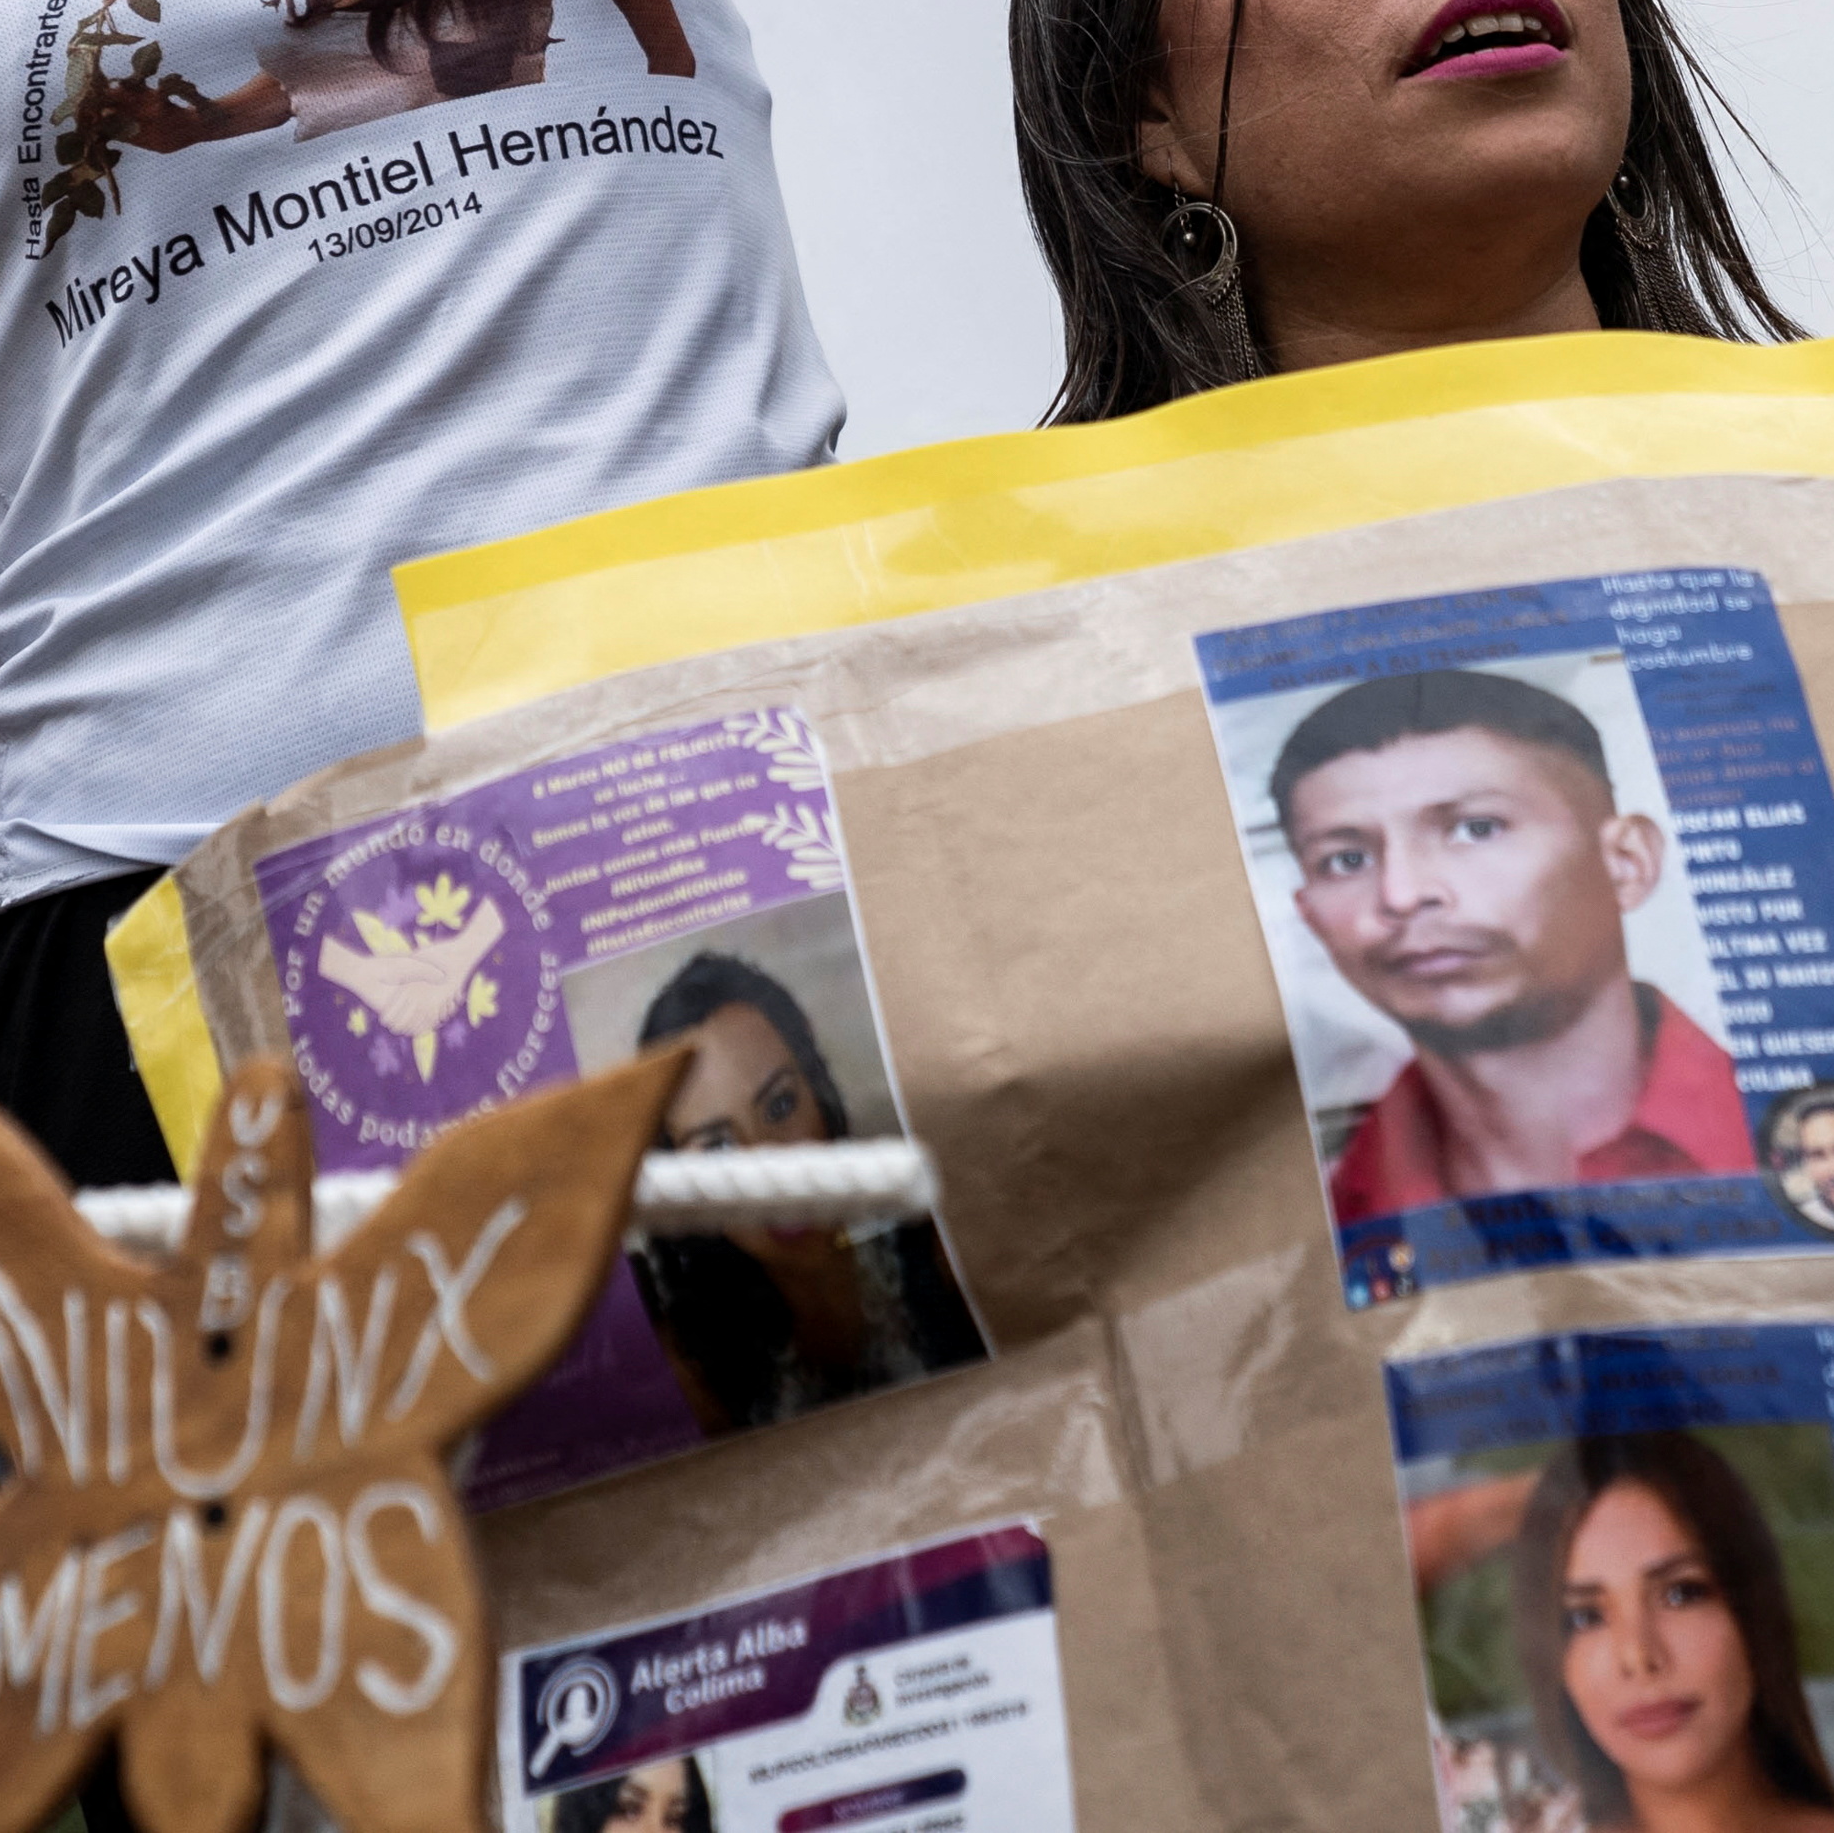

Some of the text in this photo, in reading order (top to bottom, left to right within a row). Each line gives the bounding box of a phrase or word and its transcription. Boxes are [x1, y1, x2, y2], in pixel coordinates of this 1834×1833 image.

[23, 176, 42, 261] Hasta
[45, 105, 725, 349] Mireya Montiel Hernández
[307, 191, 483, 265] 13/09/2014
[1601, 567, 1756, 597] Hasta que la
[1610, 591, 1753, 623] dignidad se
[1615, 623, 1683, 648] haga
[1625, 641, 1755, 673] costumbre
[547, 768, 600, 796] Marzo
[601, 756, 629, 778] NO
[631, 748, 656, 770] SE
[658, 731, 740, 763] FELICITA
[593, 786, 616, 806] se
[616, 771, 667, 798] lucha
[531, 772, 761, 850] Somos la voz de las que no
[1742, 801, 1807, 828] ELIAS
[545, 865, 601, 896] Juntas
[602, 846, 659, 878] somos
[282, 820, 555, 1018] por un mundo en donde
[1758, 895, 1806, 922] POR
[1781, 926, 1830, 954] VEZ
[291, 1032, 356, 1128] todas
[496, 948, 562, 1102] florecer
[1732, 1031, 1760, 1059] EN
[1735, 1062, 1816, 1094] COLIMA
[629, 1613, 810, 1696] Alerta Alba
[662, 1664, 769, 1715] Colima
